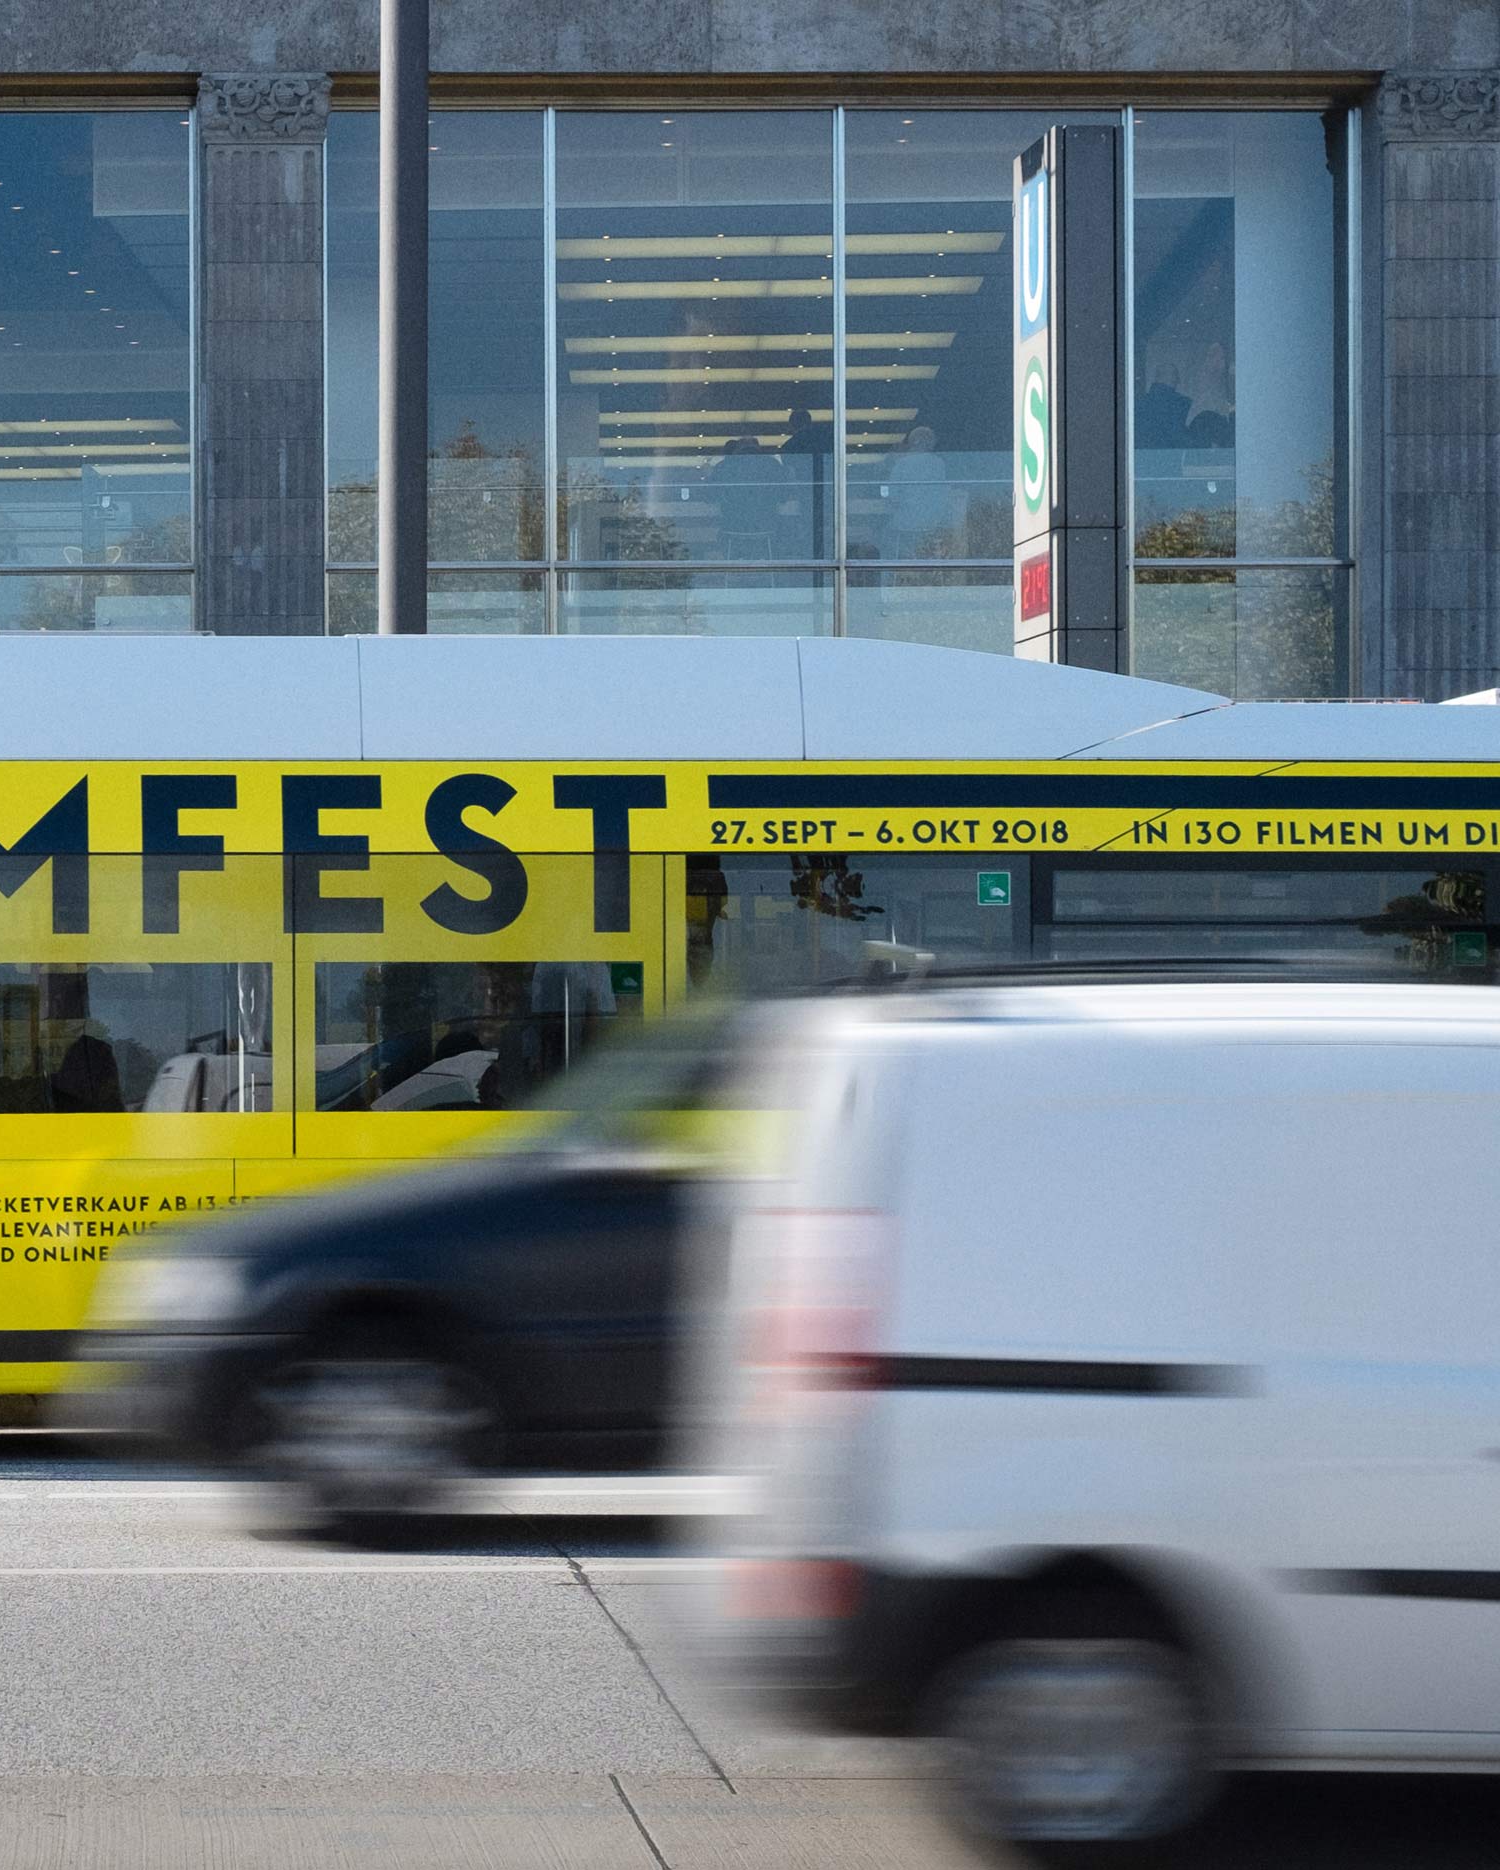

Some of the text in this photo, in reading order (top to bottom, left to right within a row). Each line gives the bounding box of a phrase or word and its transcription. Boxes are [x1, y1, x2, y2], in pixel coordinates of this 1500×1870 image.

[1022, 181, 1045, 324] U
[1022, 370, 1045, 502] S
[711, 820, 754, 844] 27.
[762, 820, 837, 844] SEPT
[876, 820, 905, 844] 6.
[912, 820, 981, 844] OKT
[992, 819, 1069, 844] 2018
[1133, 820, 1168, 844] IN
[1184, 821, 1241, 845] 130
[1256, 821, 1383, 845] FILMEN
[1398, 821, 1449, 846] UM
[158, 1196, 188, 1212] AB
[24, 1245, 109, 1263] ONLINE
